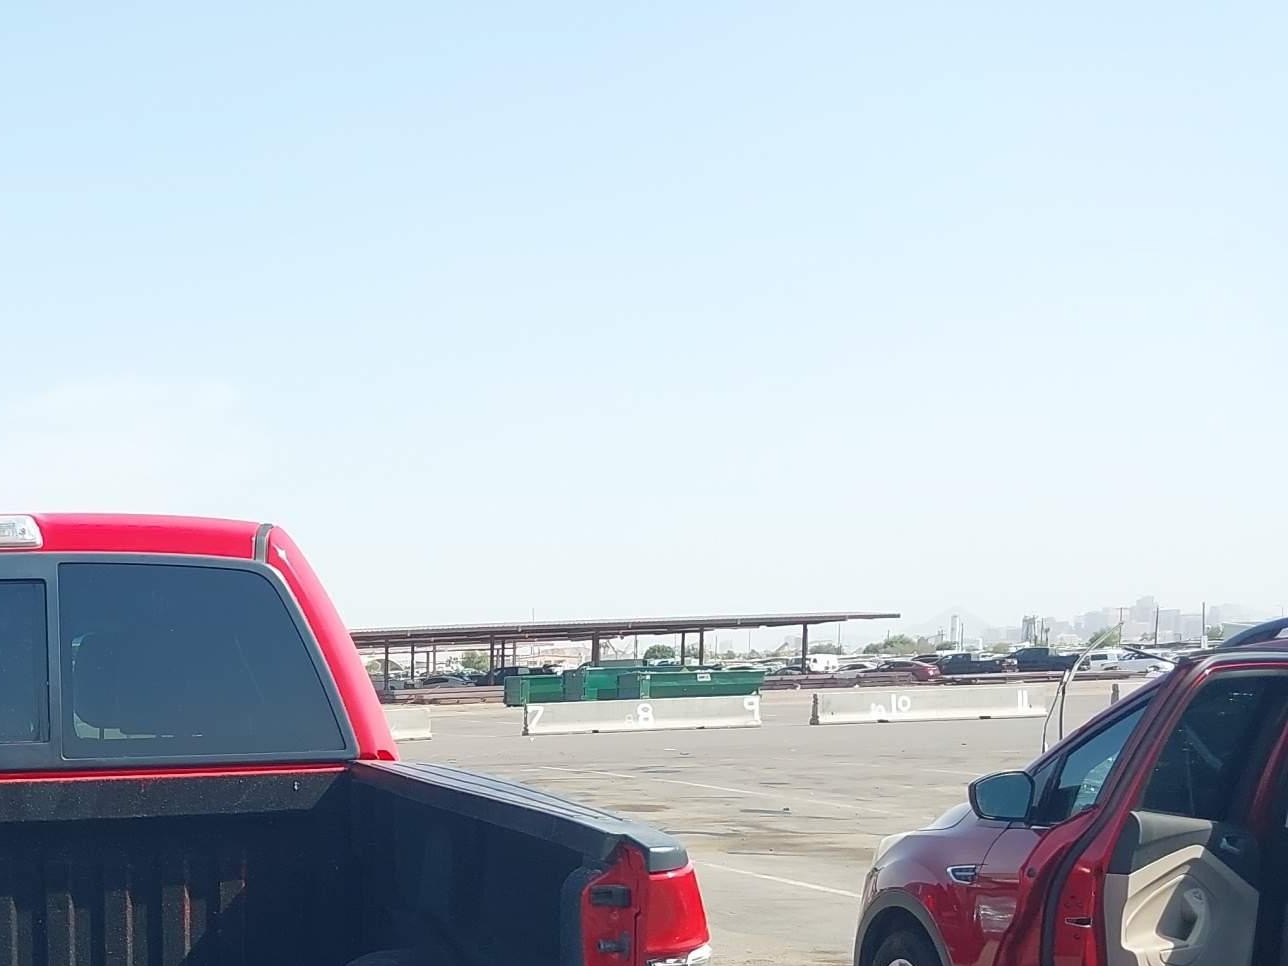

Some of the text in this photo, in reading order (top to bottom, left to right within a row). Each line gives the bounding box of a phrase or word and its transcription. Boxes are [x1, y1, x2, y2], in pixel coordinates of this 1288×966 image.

[637, 703, 654, 727] 8
[743, 696, 760, 721] 9
[891, 694, 911, 713] 10
[527, 705, 544, 733] 7
